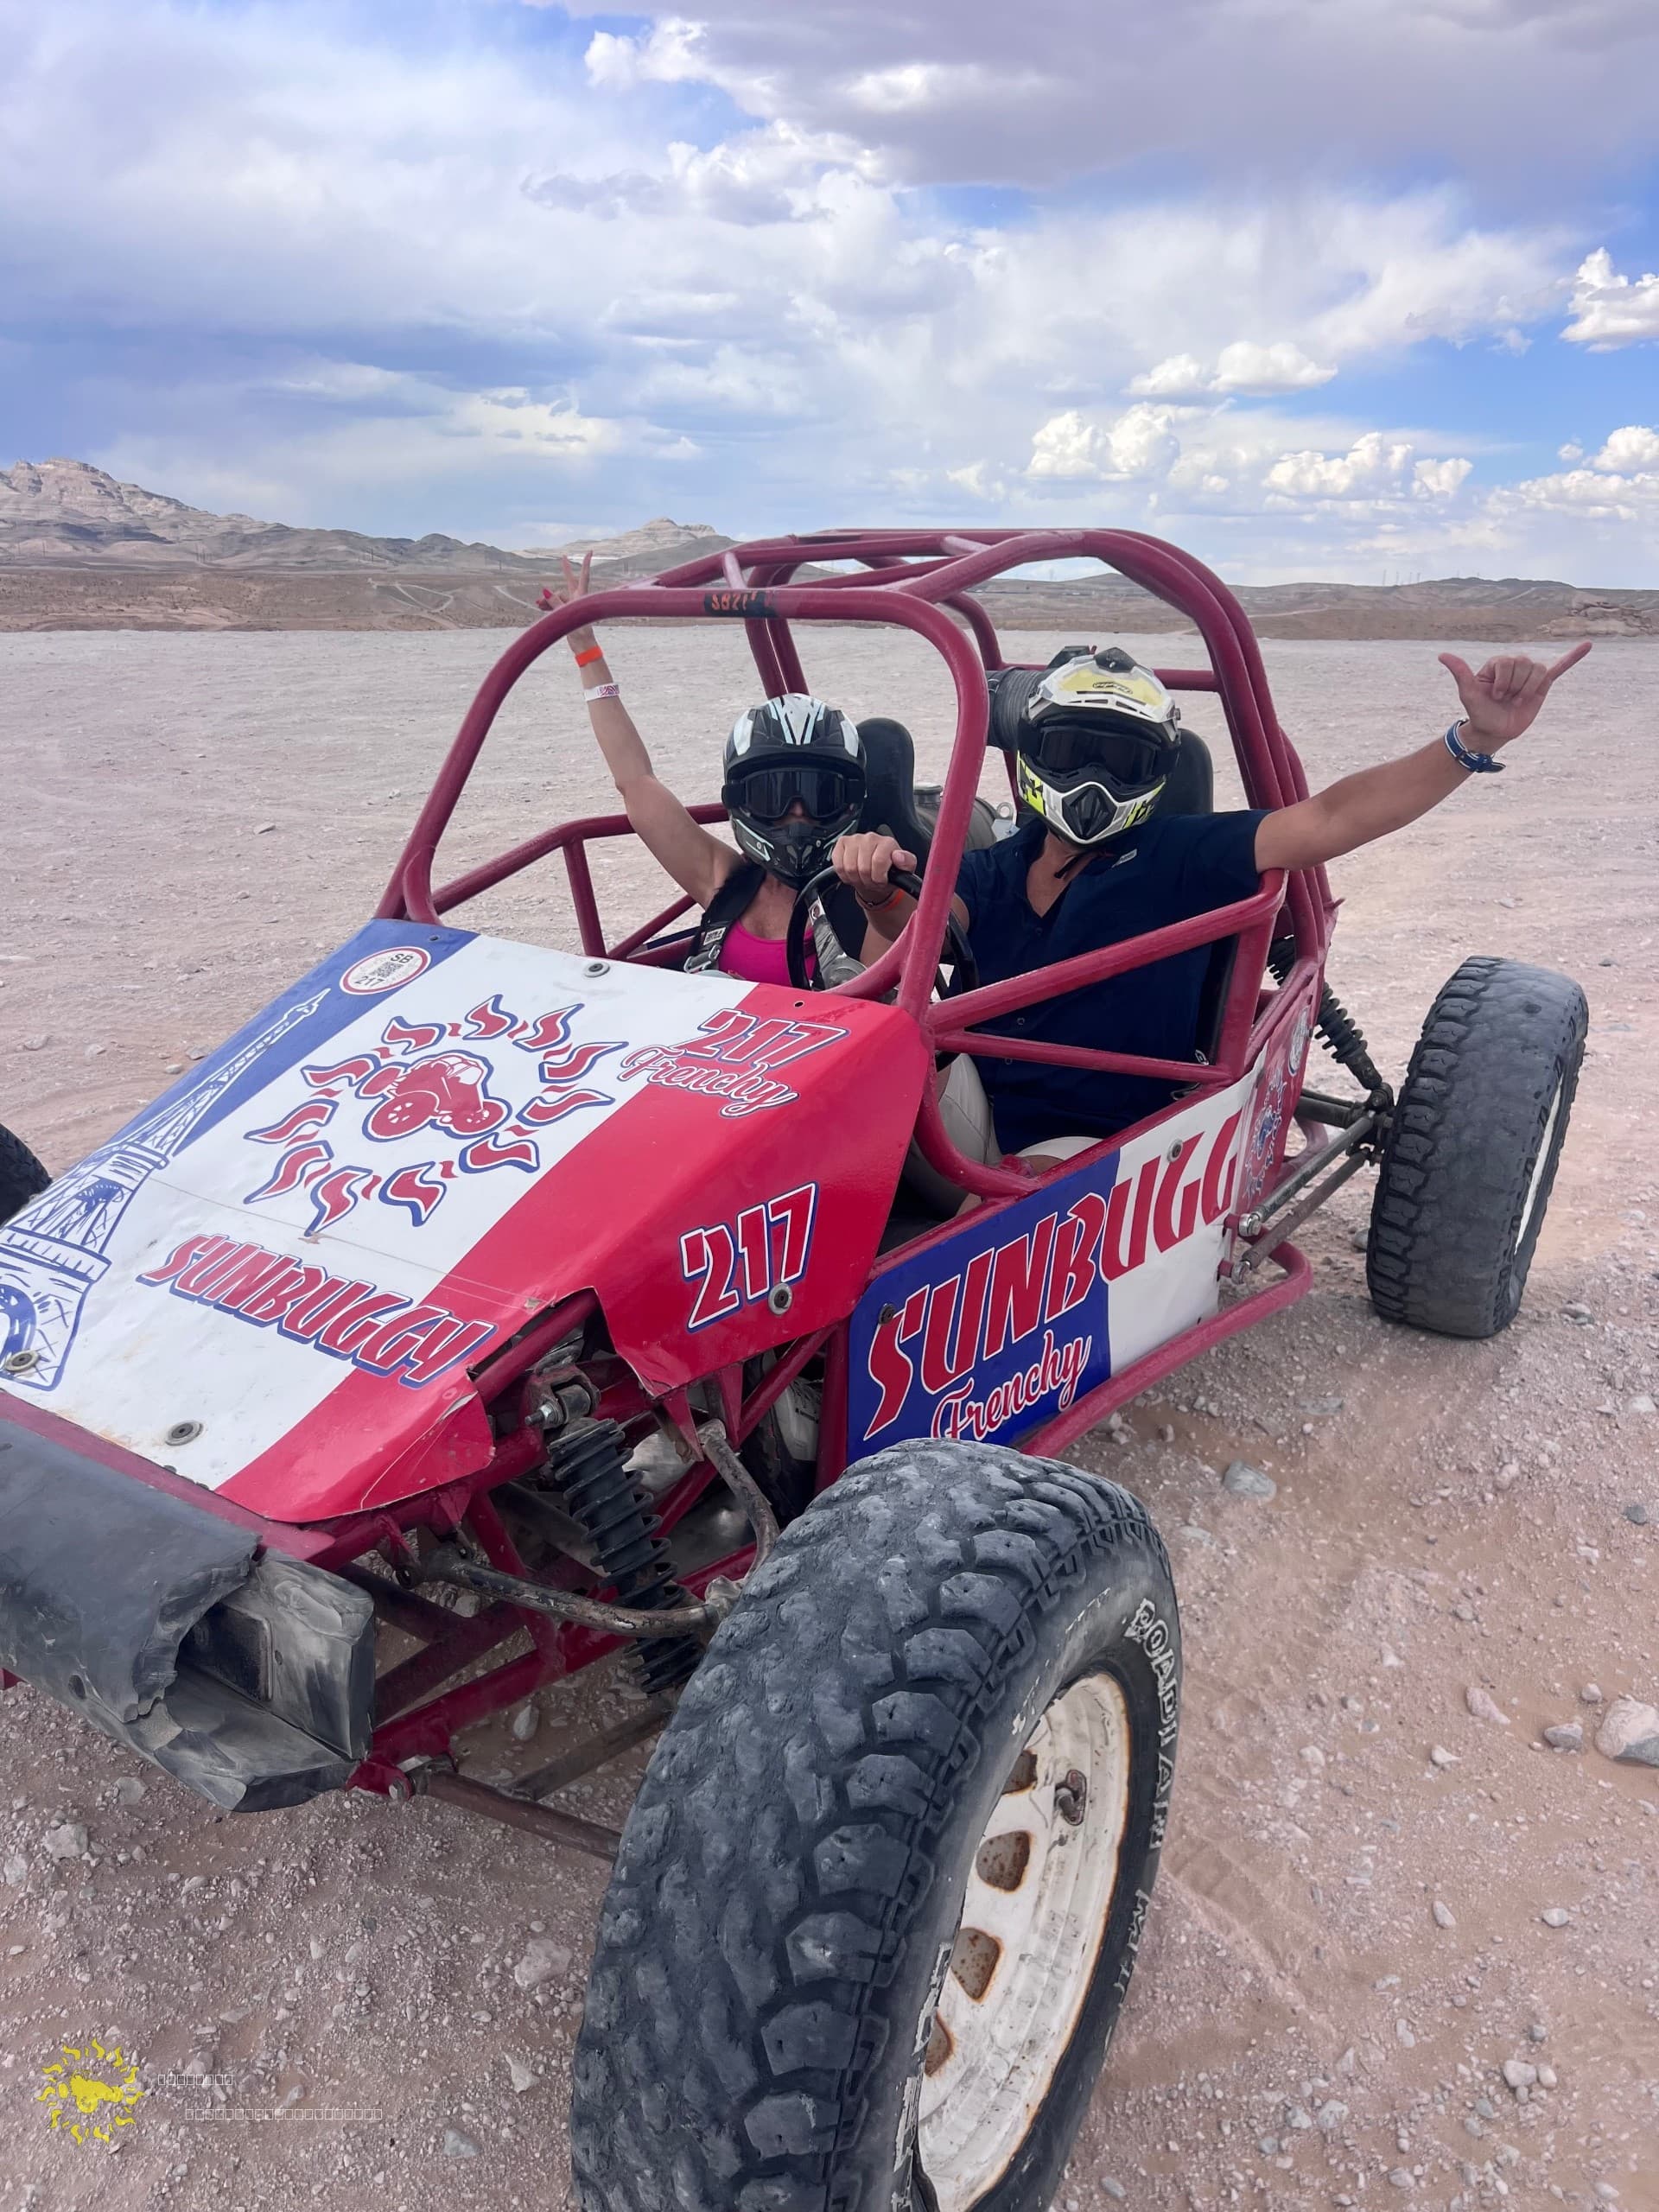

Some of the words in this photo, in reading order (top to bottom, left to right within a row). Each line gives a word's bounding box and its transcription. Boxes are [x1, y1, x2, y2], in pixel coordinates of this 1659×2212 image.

[354, 976, 386, 988] 217
[391, 953, 415, 963] SB
[669, 1007, 850, 1069] 217
[617, 1044, 800, 1117] Frenchy
[679, 1180, 818, 1333] 217
[136, 1234, 499, 1389] SUNBUGGY
[931, 1329, 1092, 1439] Frenchy
